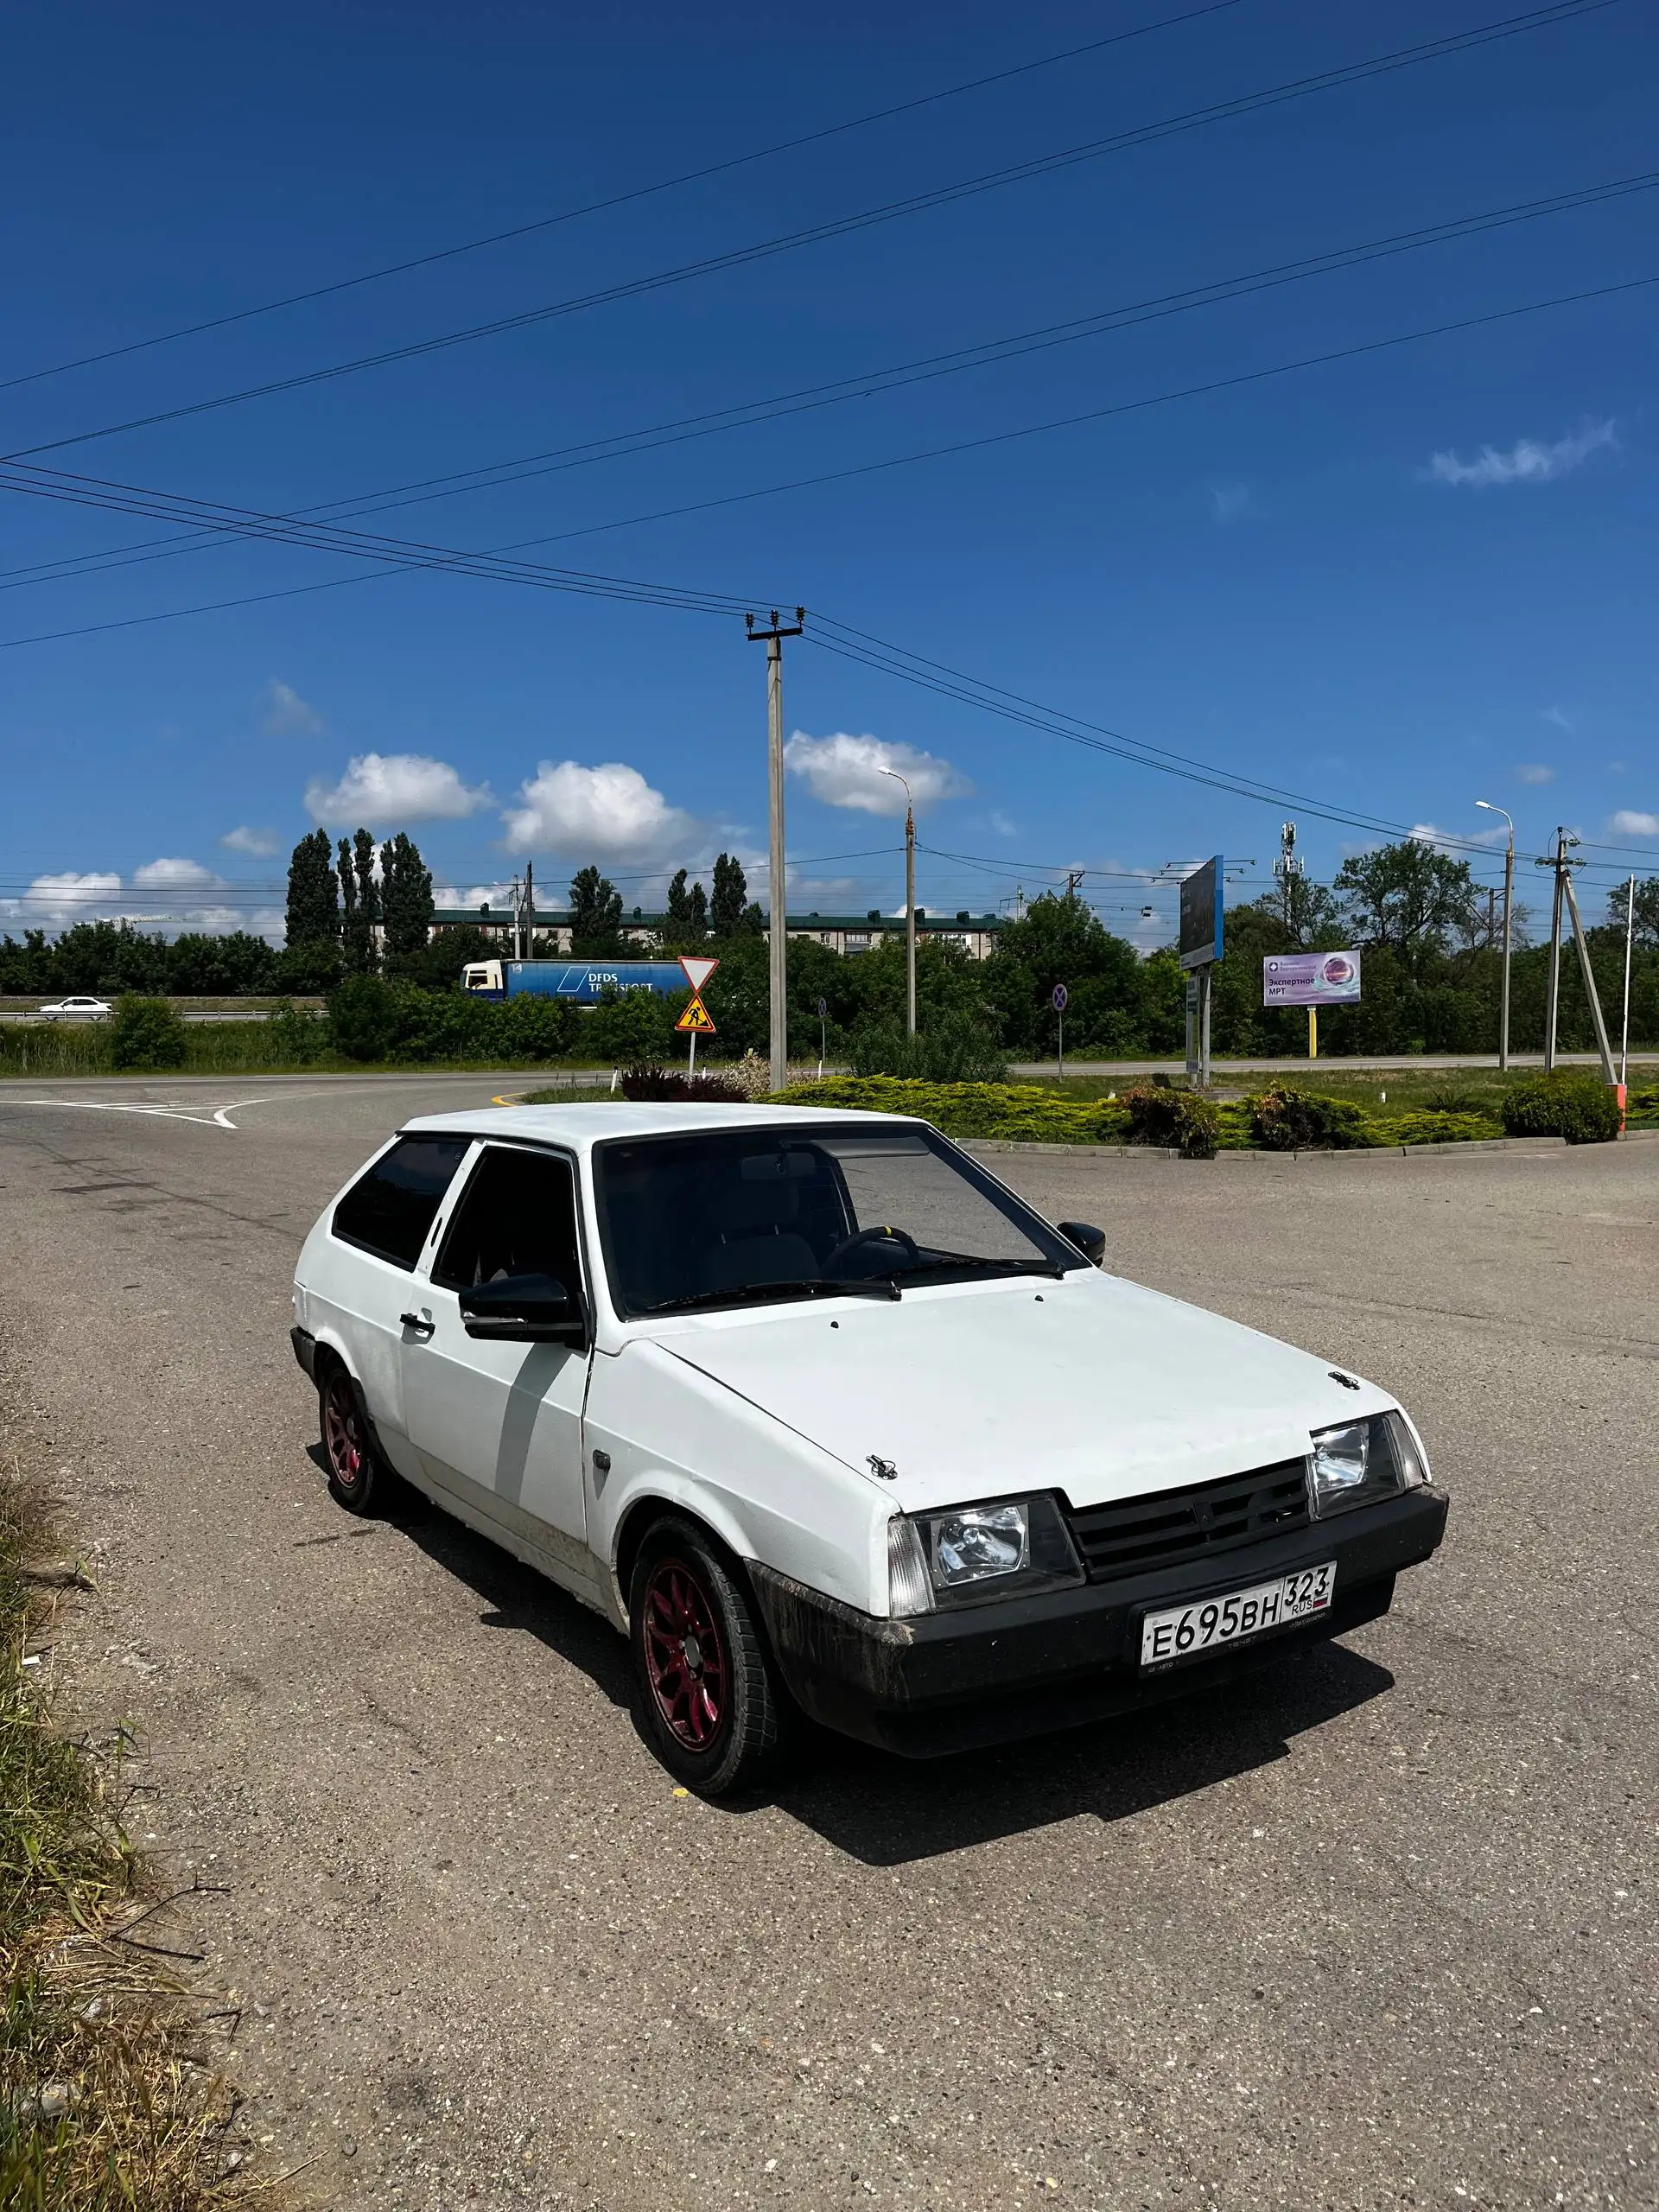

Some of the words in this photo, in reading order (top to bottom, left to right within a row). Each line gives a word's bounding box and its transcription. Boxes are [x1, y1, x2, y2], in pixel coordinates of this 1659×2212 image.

[588, 973, 618, 982] DFDS
[1268, 977, 1315, 987] Экспертное
[1268, 988, 1286, 996] МРТ
[1153, 1592, 1280, 1658] Е695ВН
[1284, 1567, 1330, 1606] 323
[1291, 1599, 1313, 1616] RUS
